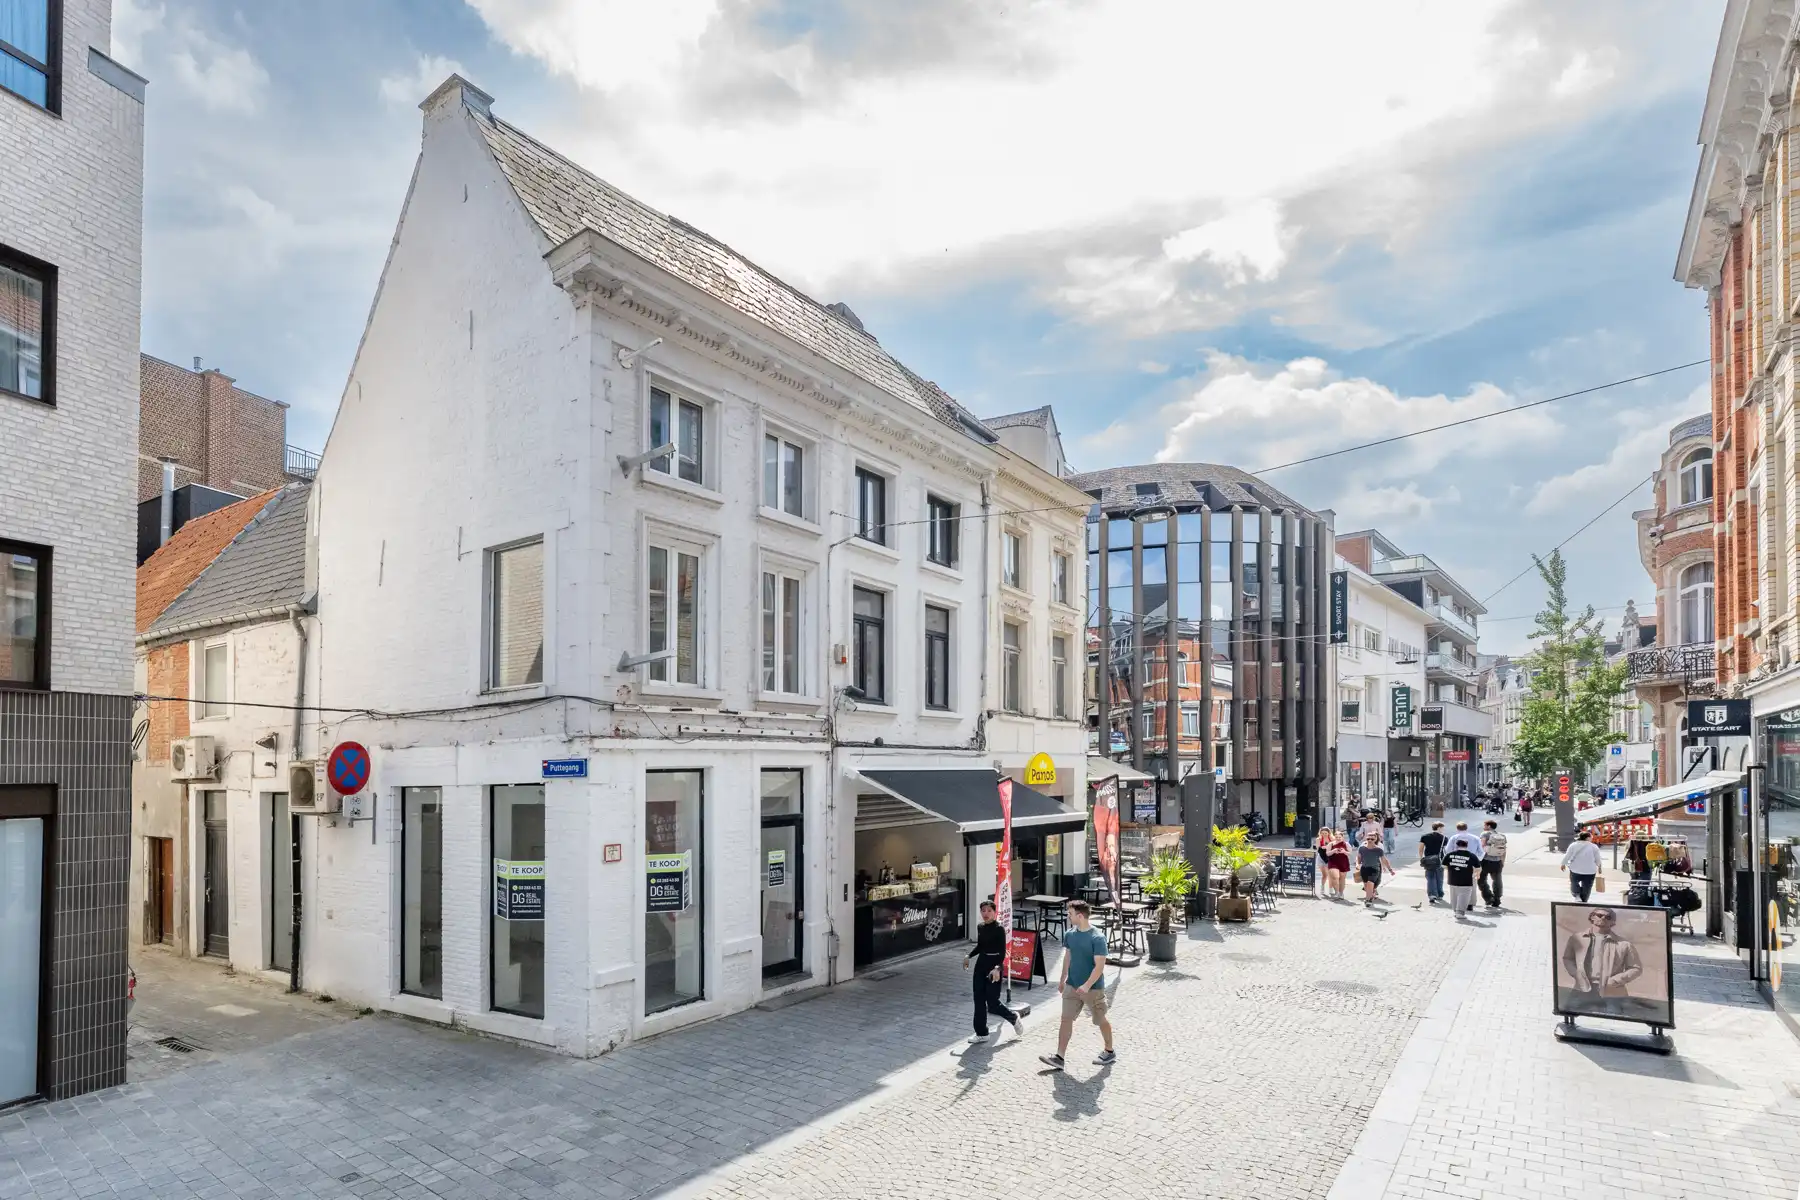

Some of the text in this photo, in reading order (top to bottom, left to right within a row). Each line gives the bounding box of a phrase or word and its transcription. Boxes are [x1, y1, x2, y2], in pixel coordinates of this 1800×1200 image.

[1395, 690, 1406, 725] JULES
[1032, 769, 1054, 781] Panos
[650, 886, 663, 896] DG
[512, 893, 525, 903] DG
